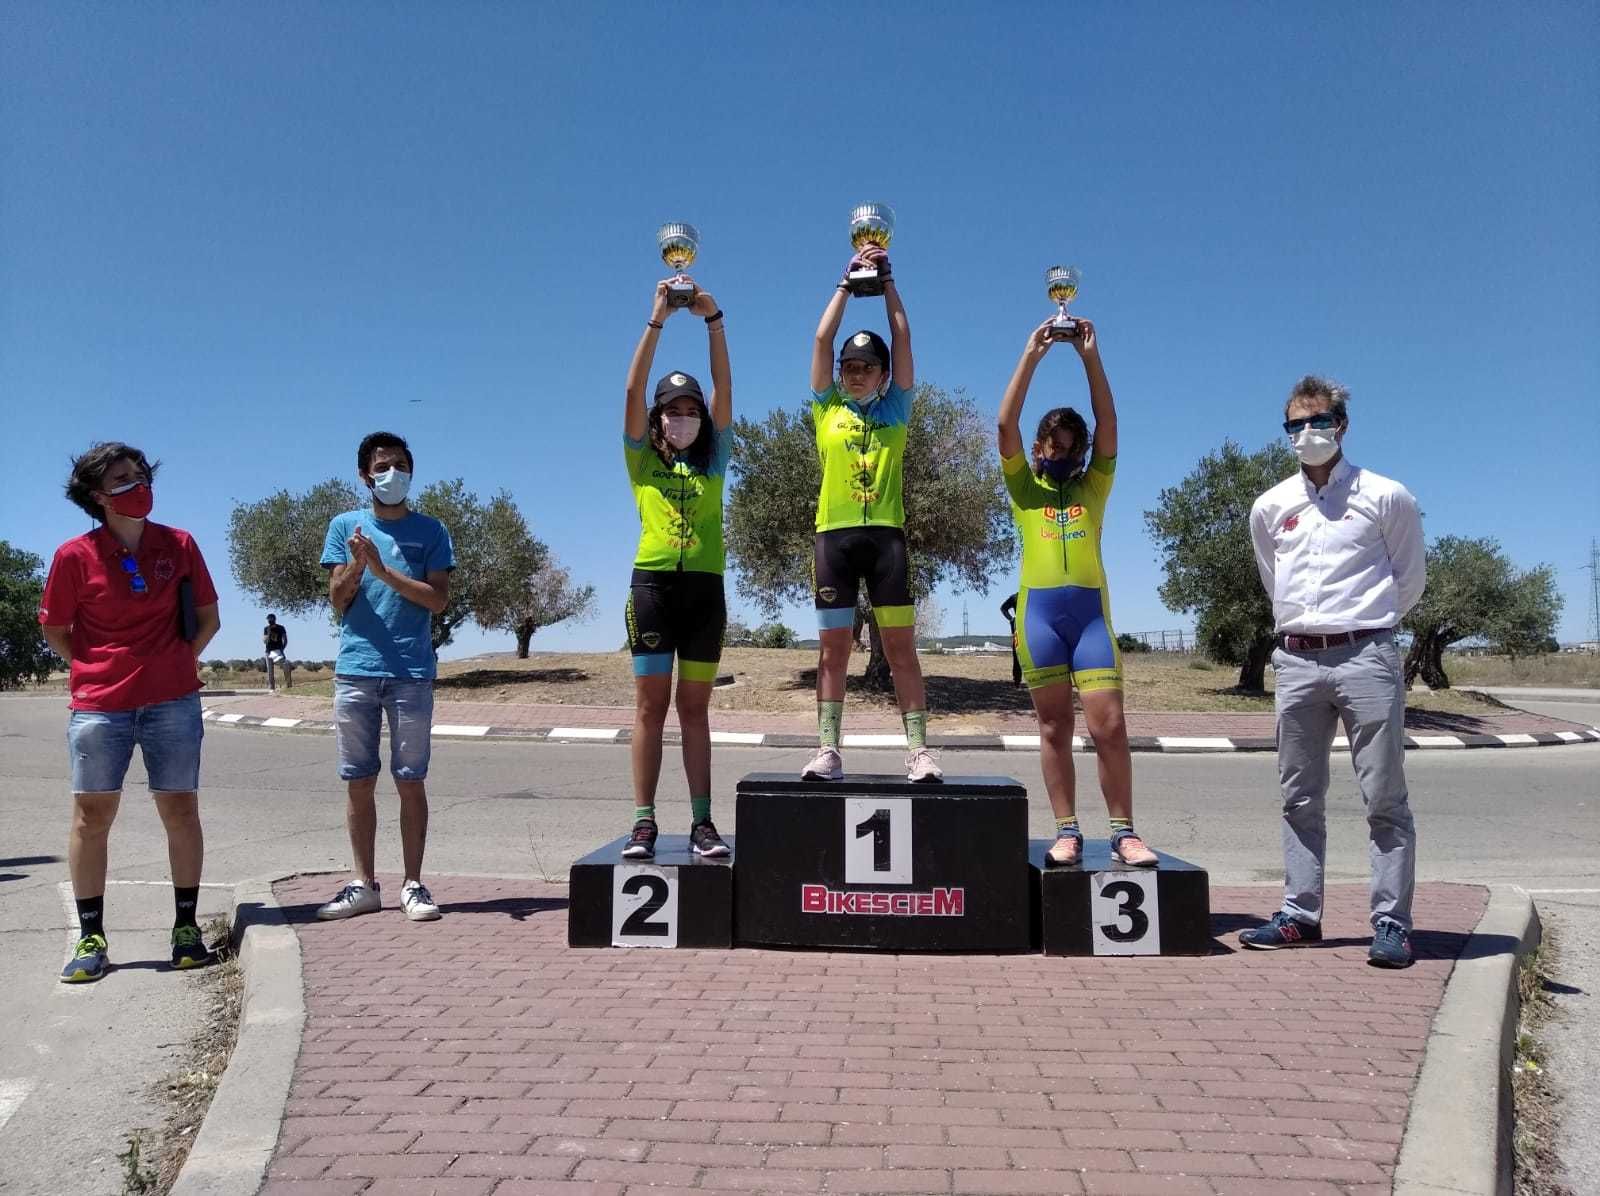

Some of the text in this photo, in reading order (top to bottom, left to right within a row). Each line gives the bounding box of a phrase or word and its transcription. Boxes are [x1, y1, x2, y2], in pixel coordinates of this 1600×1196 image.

[856, 809, 891, 872] 1
[620, 875, 669, 937] 2
[802, 884, 964, 916] BIKESCIEM
[1100, 881, 1149, 943] 3
